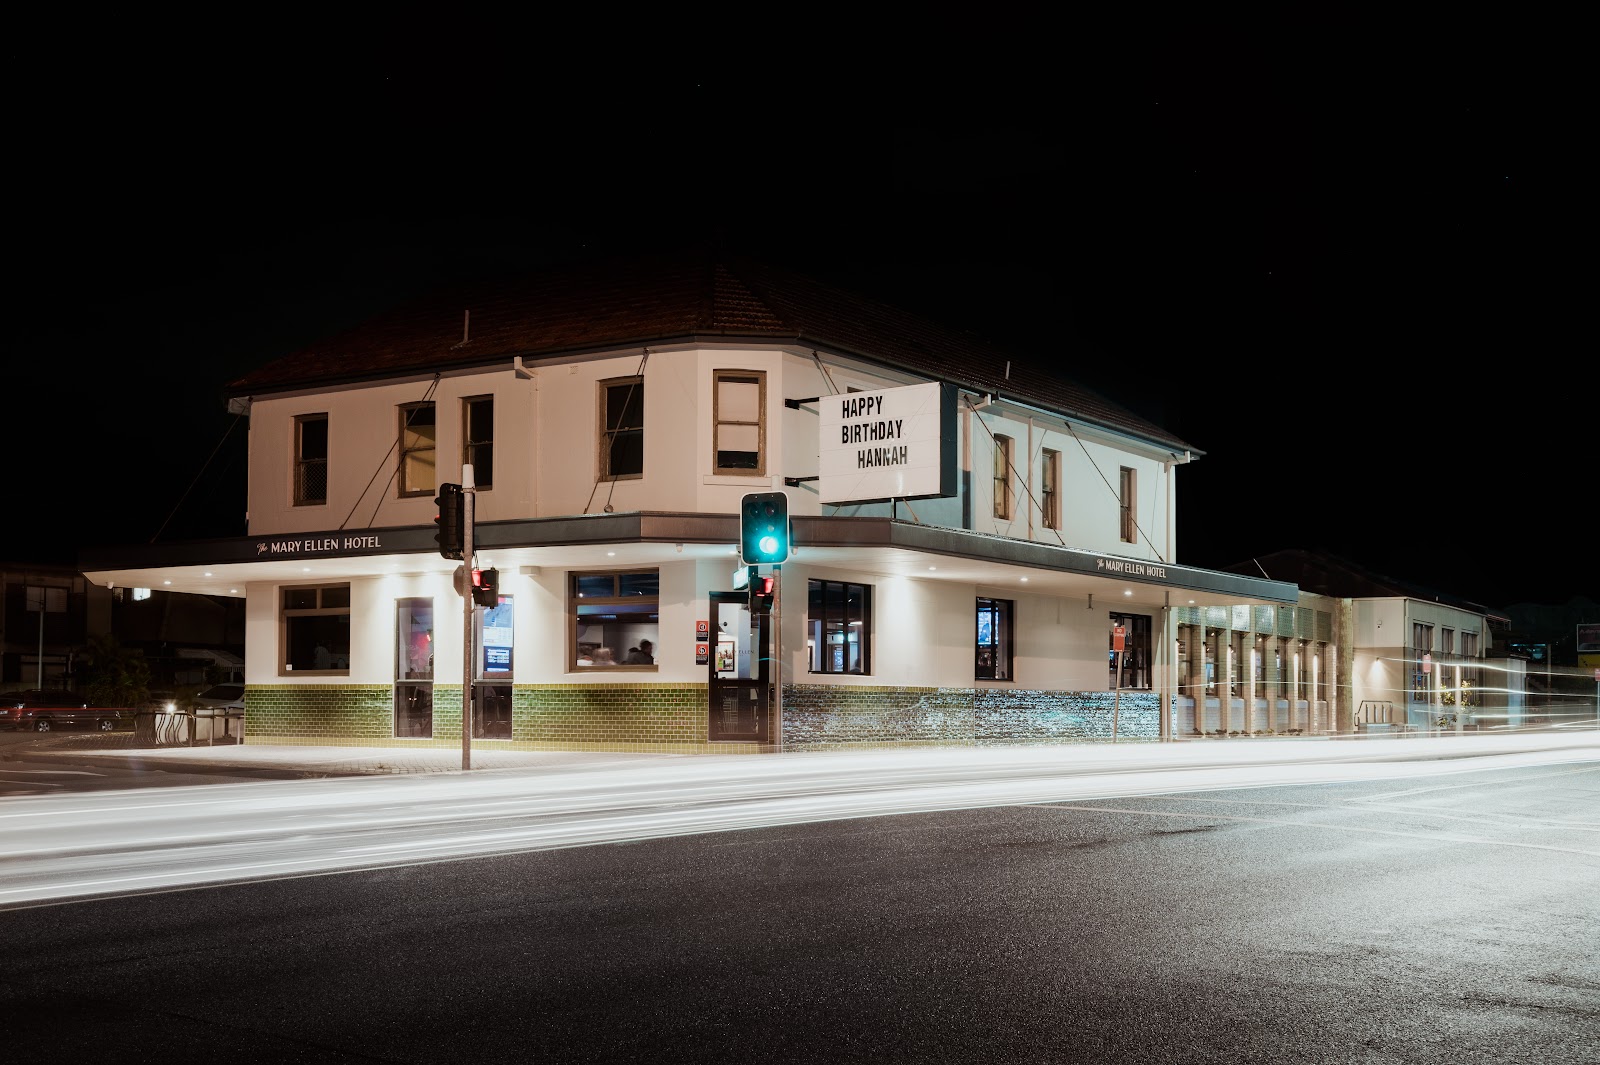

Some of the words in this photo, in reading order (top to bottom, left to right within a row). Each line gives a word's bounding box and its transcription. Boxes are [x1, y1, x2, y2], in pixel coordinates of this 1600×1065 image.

[842, 395, 883, 419] HAPPY
[842, 419, 903, 444] BIRTHDAY
[857, 445, 908, 469] HANNAH
[257, 543, 269, 555] The
[271, 540, 302, 554] MARY
[304, 538, 339, 552] ELLEN
[344, 536, 382, 549] HOTEL
[1096, 558, 1105, 571] The
[1105, 559, 1124, 572] MARY
[1124, 562, 1145, 575] ELLEN
[1146, 566, 1167, 578] HOTEL
